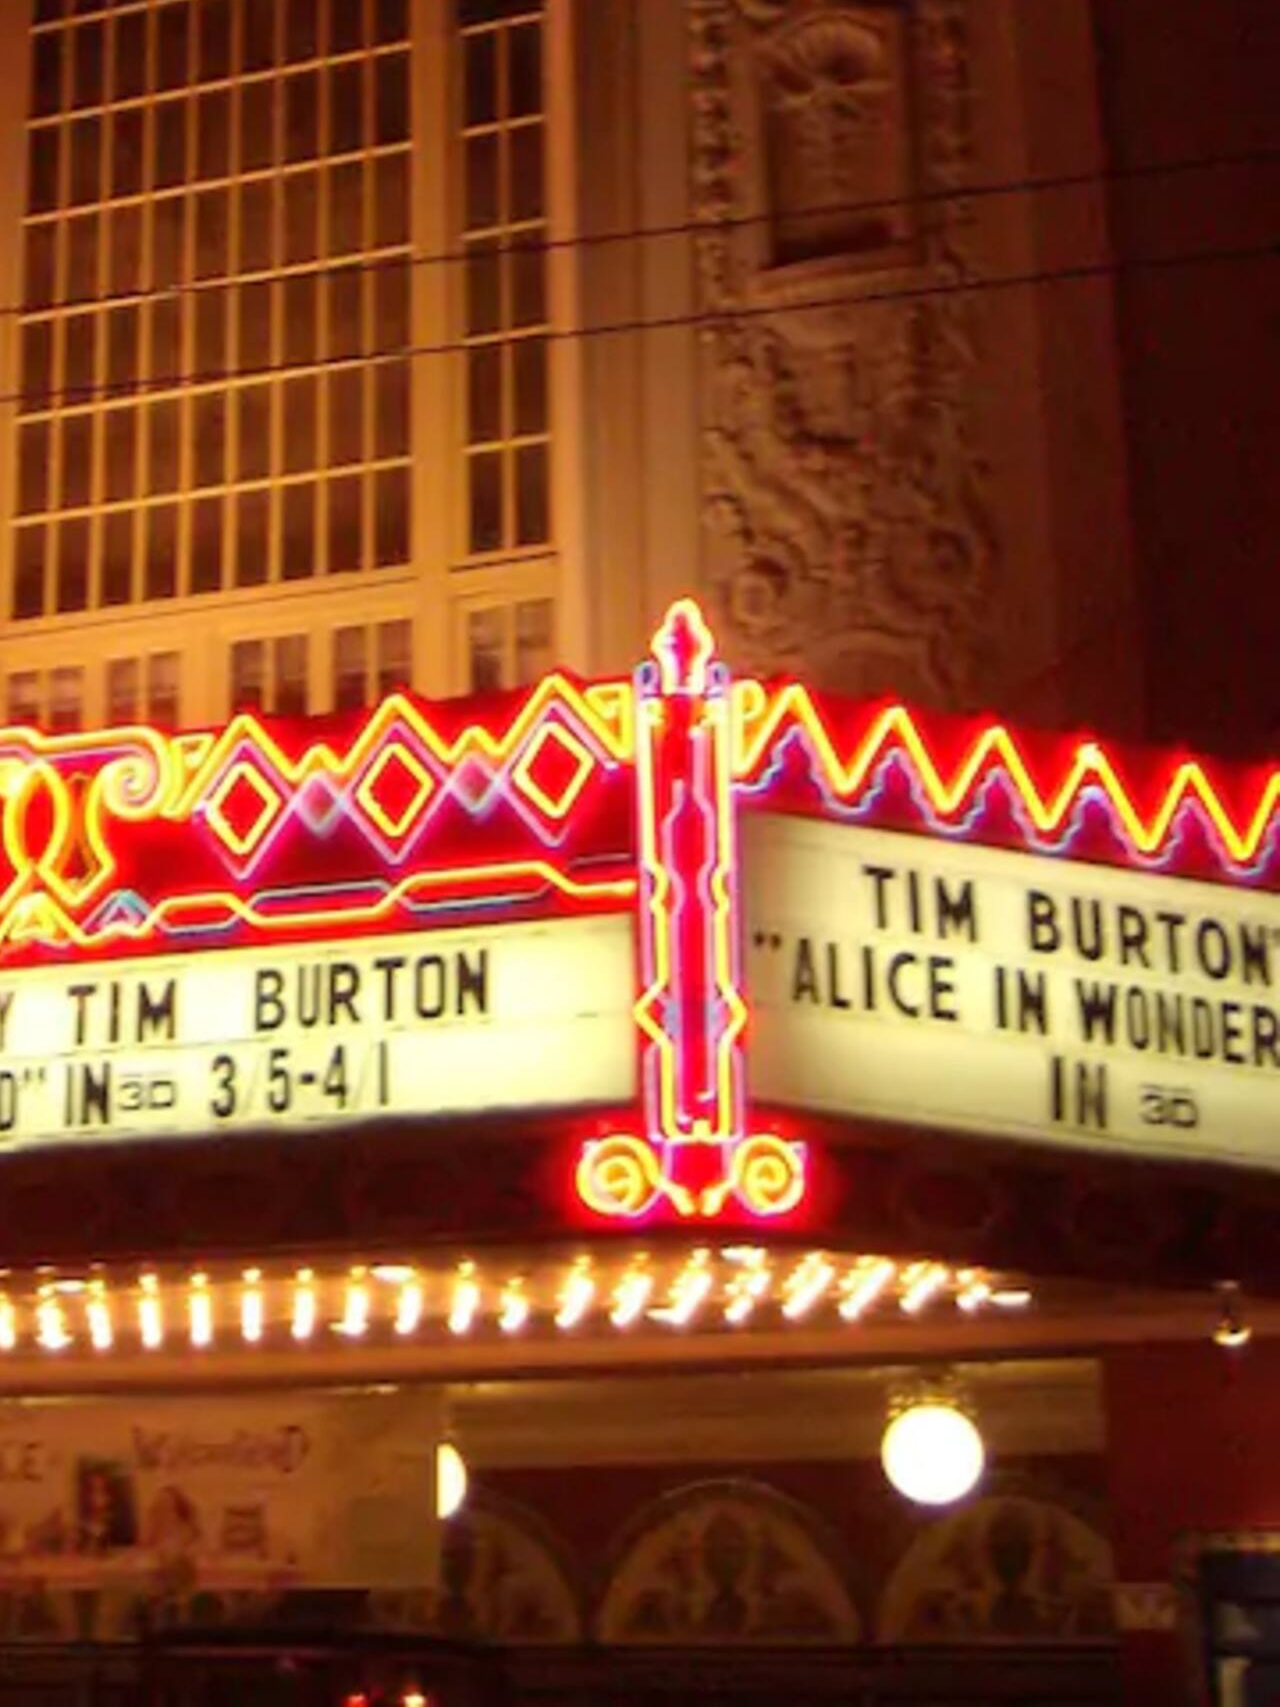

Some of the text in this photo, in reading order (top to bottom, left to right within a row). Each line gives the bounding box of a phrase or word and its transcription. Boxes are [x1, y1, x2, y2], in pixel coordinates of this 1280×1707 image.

[861, 864, 978, 944] TIM
[67, 978, 179, 1048] TIM
[254, 949, 491, 1033] BURTON
[993, 966, 1049, 1037] IN
[64, 1061, 112, 1127] IN
[118, 1078, 177, 1112] 3D
[1051, 1056, 1200, 1130] IN 3D
